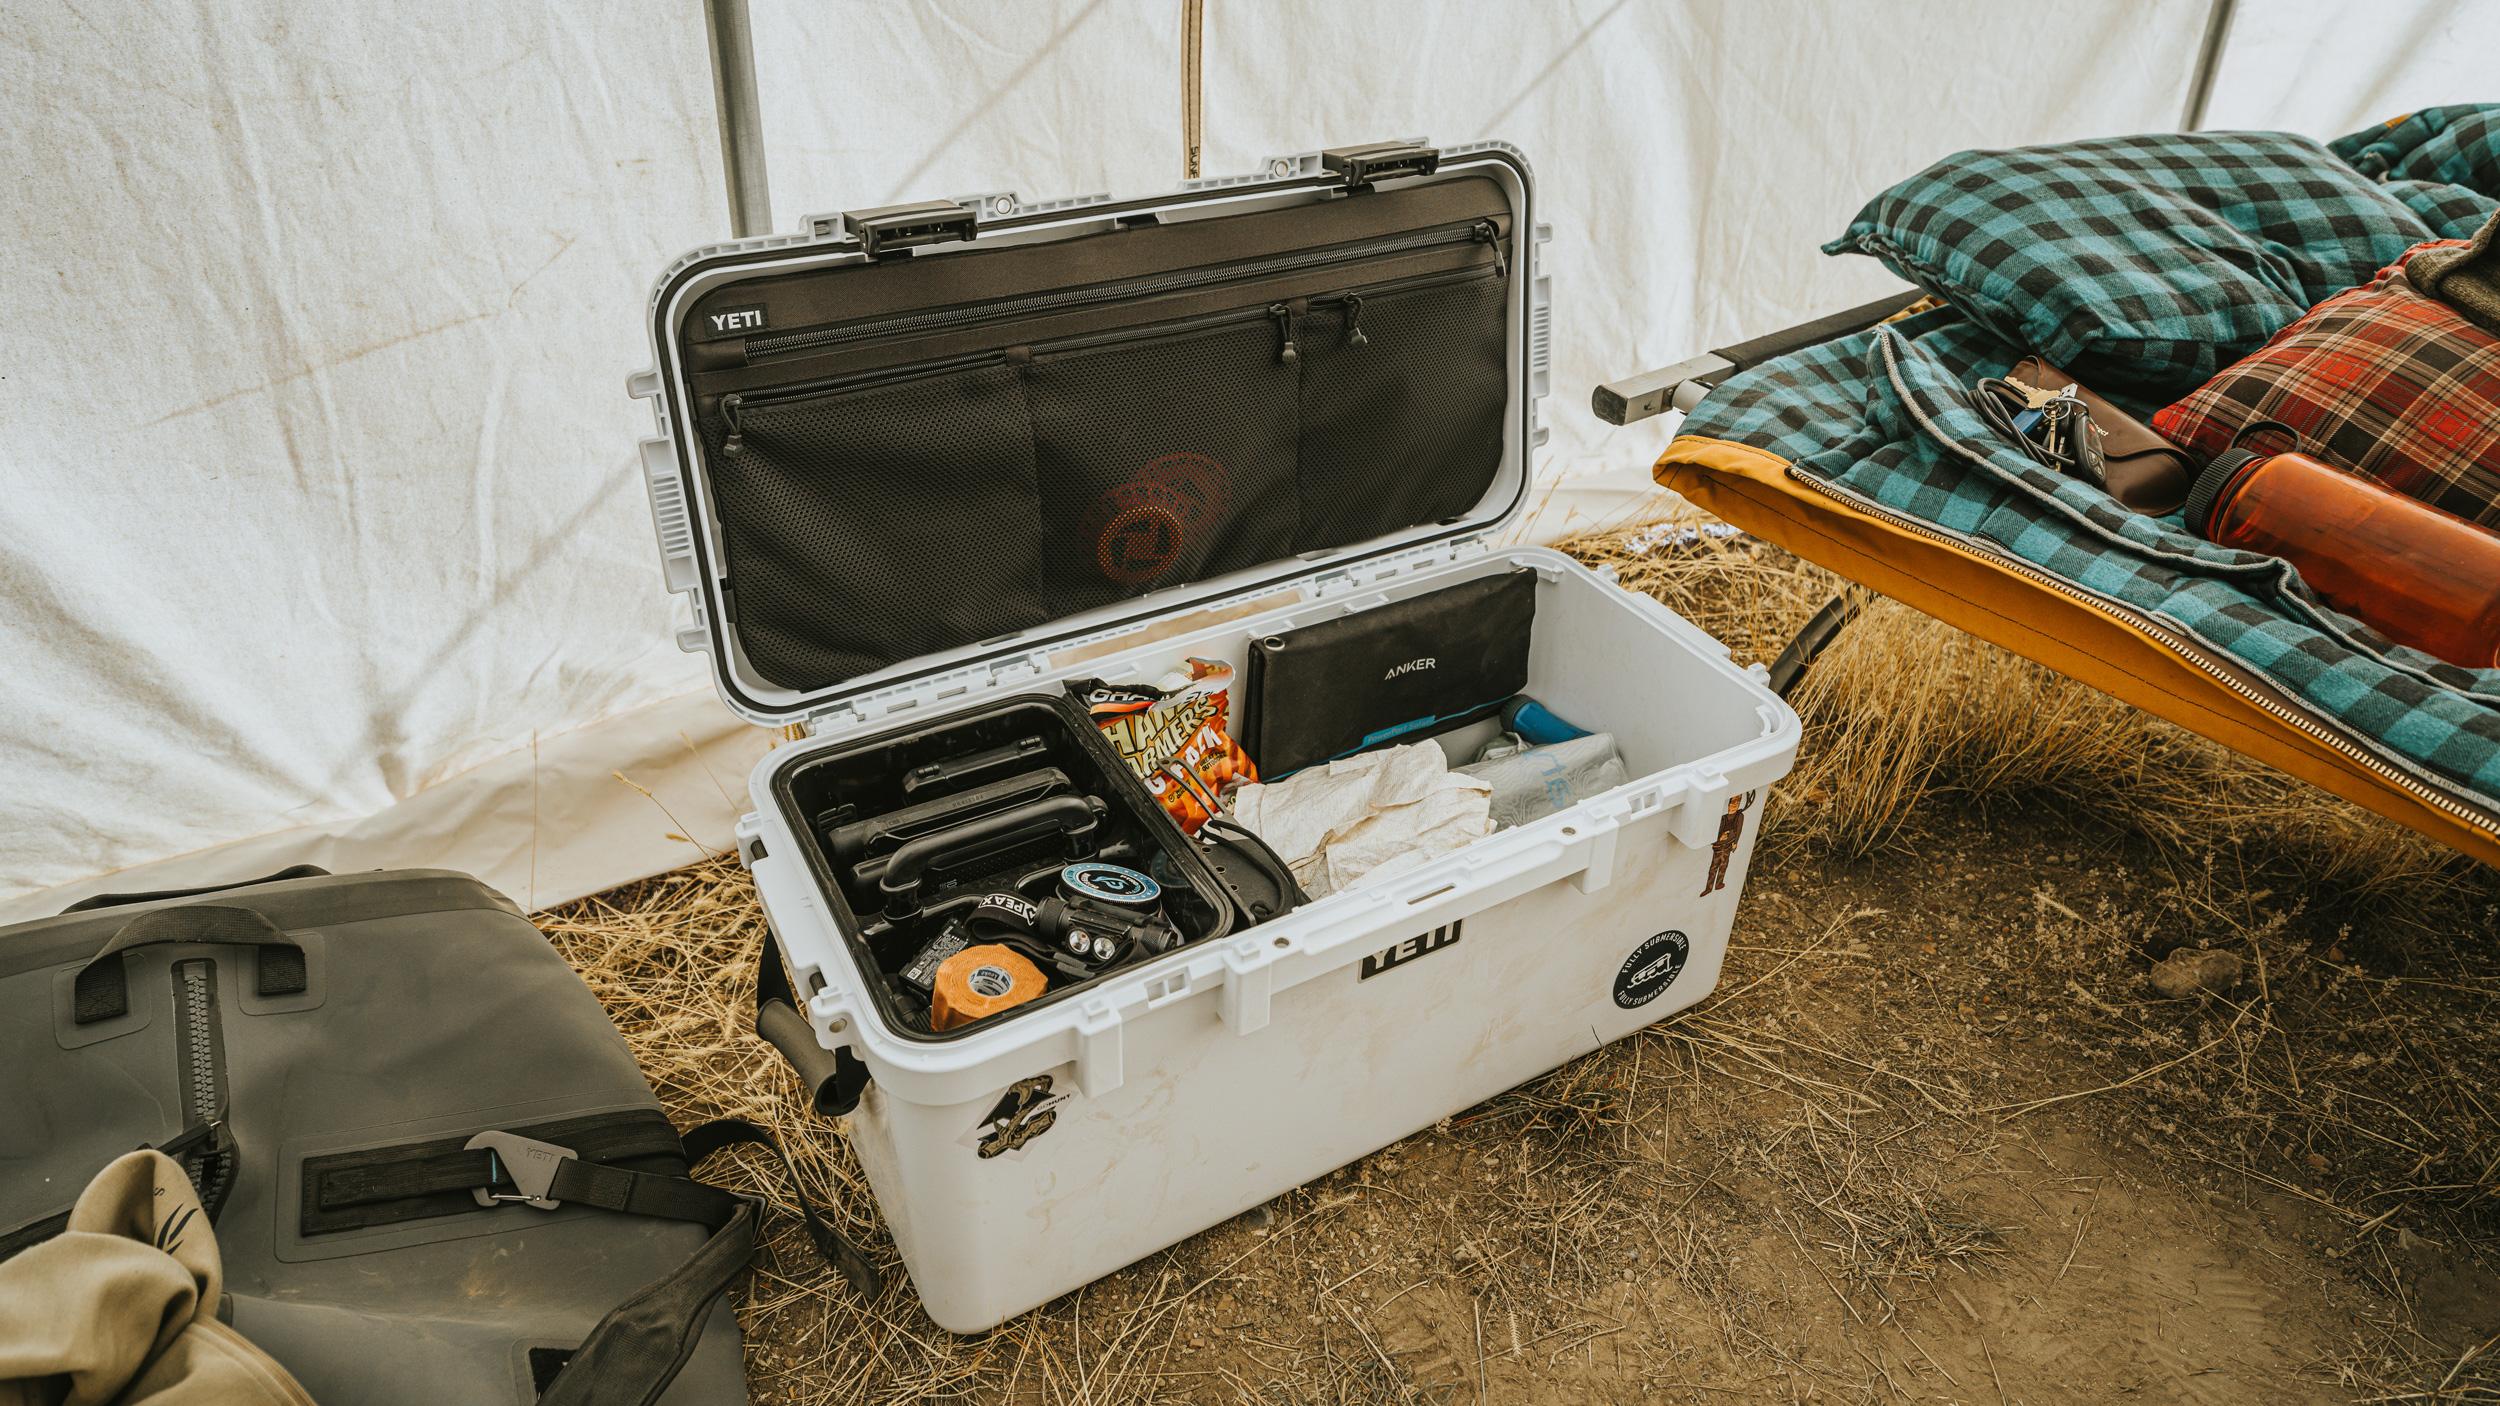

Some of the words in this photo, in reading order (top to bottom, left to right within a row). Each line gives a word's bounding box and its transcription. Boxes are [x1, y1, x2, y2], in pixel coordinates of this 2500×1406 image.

[1190, 146, 1198, 178] SUNF
[710, 310, 761, 331] YETI
[1384, 657, 1436, 681] ANKER
[982, 896, 1024, 913] PEAX
[1622, 948, 1643, 973] FULLY
[1644, 932, 1687, 951] SUBMERSIBLE
[1618, 990, 1634, 1005] FULLY
[1632, 964, 1681, 1006] SUBMERSIBLE
[527, 1147, 555, 1162] YETI
